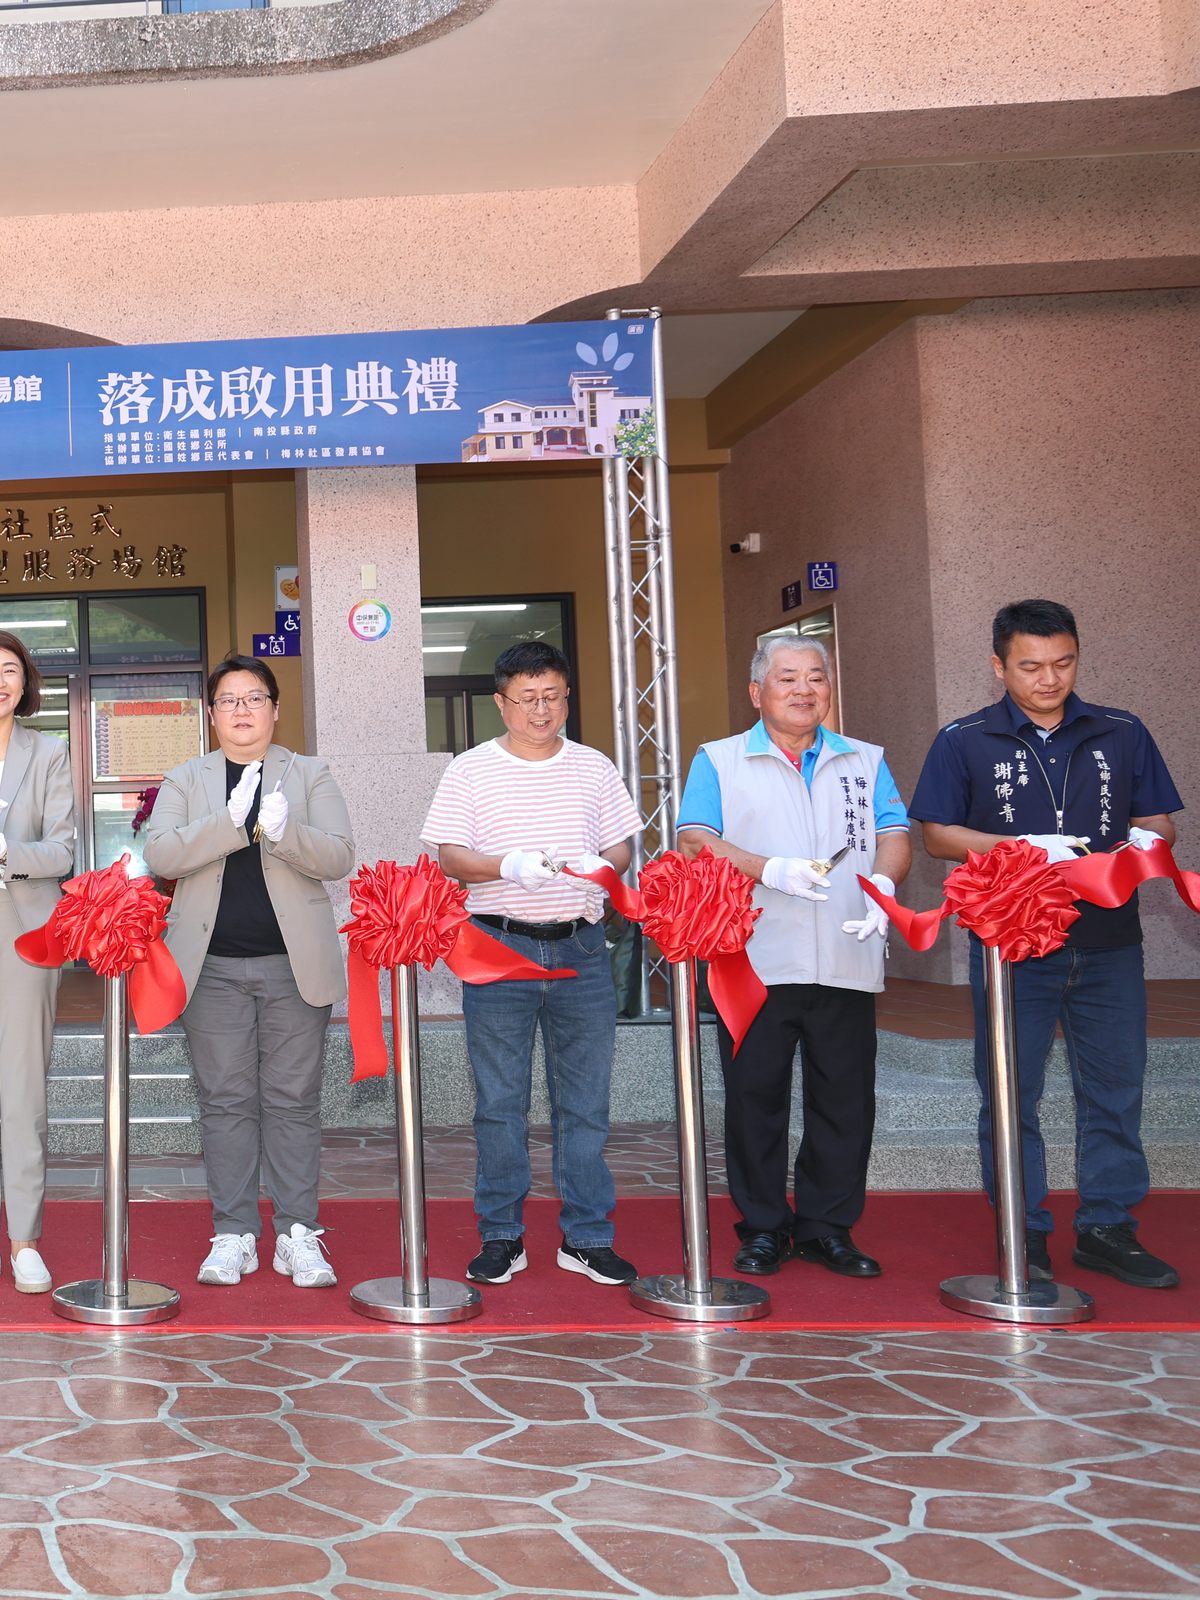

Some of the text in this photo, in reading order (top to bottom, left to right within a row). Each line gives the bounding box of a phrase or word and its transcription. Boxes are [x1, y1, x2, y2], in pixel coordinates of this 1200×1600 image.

[98, 356, 462, 426] 落成啟用典禮
[253, 425, 318, 437] 南投縣政府
[281, 445, 386, 459] 梅林社區發展協會
[1015, 749, 1029, 787] 副主席
[1092, 750, 1112, 836] 國姓鄉民代表會
[855, 775, 869, 852] 梅林社區
